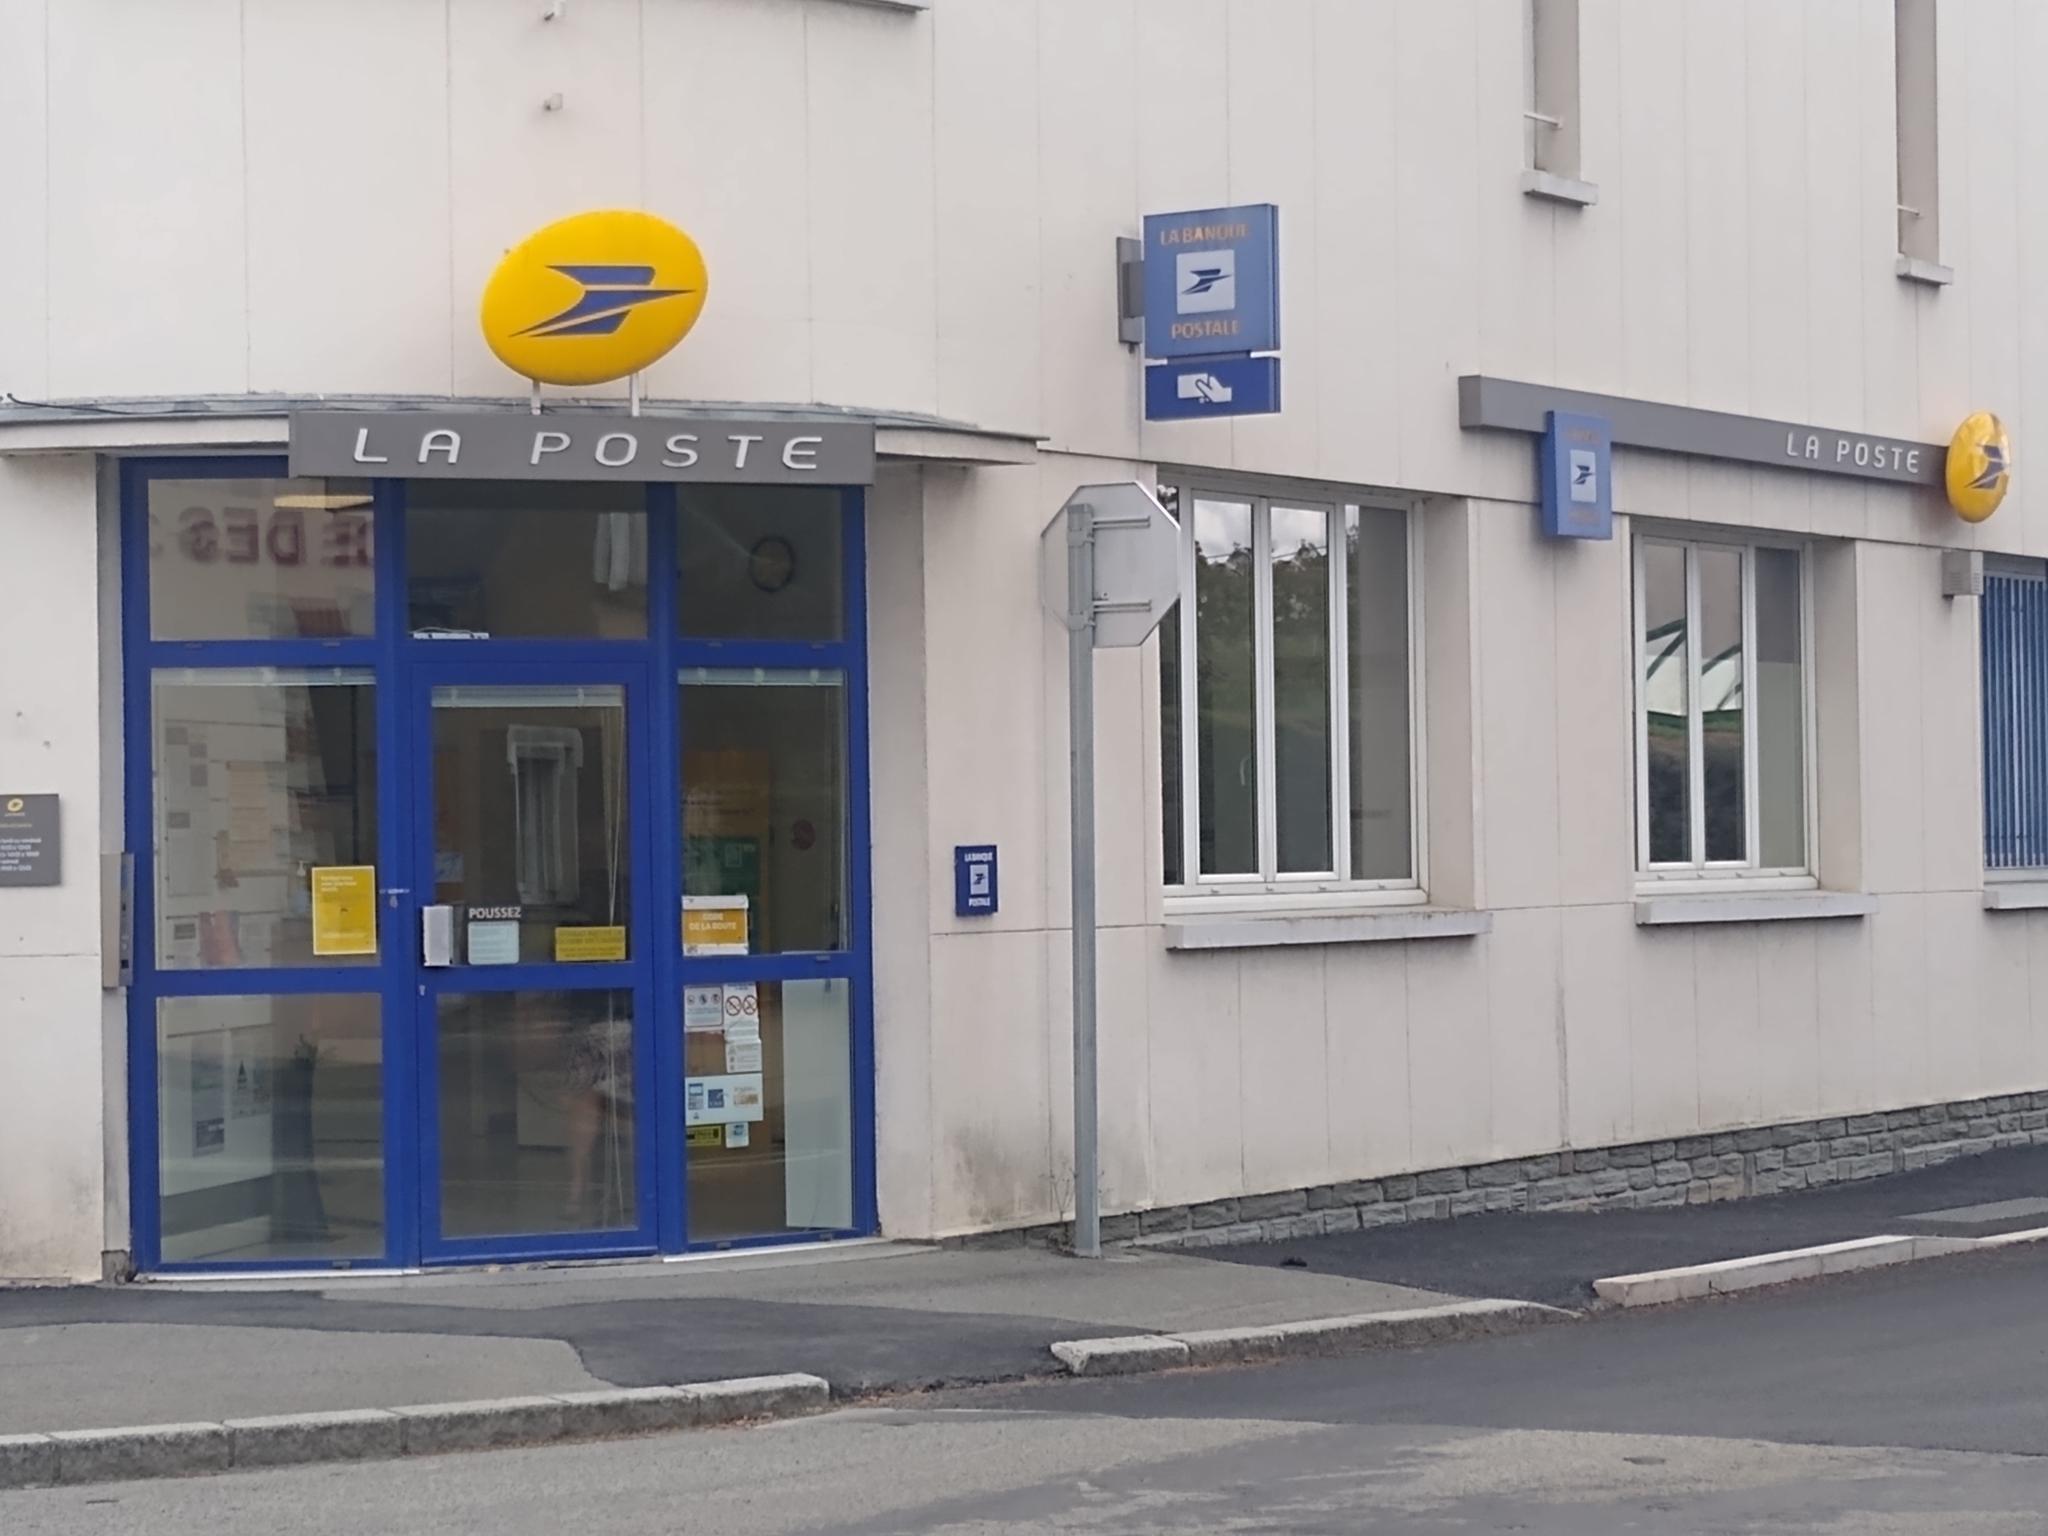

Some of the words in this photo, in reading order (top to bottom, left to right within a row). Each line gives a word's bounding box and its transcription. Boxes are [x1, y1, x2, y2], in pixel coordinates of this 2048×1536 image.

[1161, 228, 1180, 247] LA
[1172, 320, 1239, 339] POSTALE
[353, 427, 462, 465] LA
[530, 432, 824, 471] POSTE
[1786, 432, 1820, 460] LA
[1836, 440, 1920, 474] POSTE
[468, 907, 522, 920] POUSSEZ
